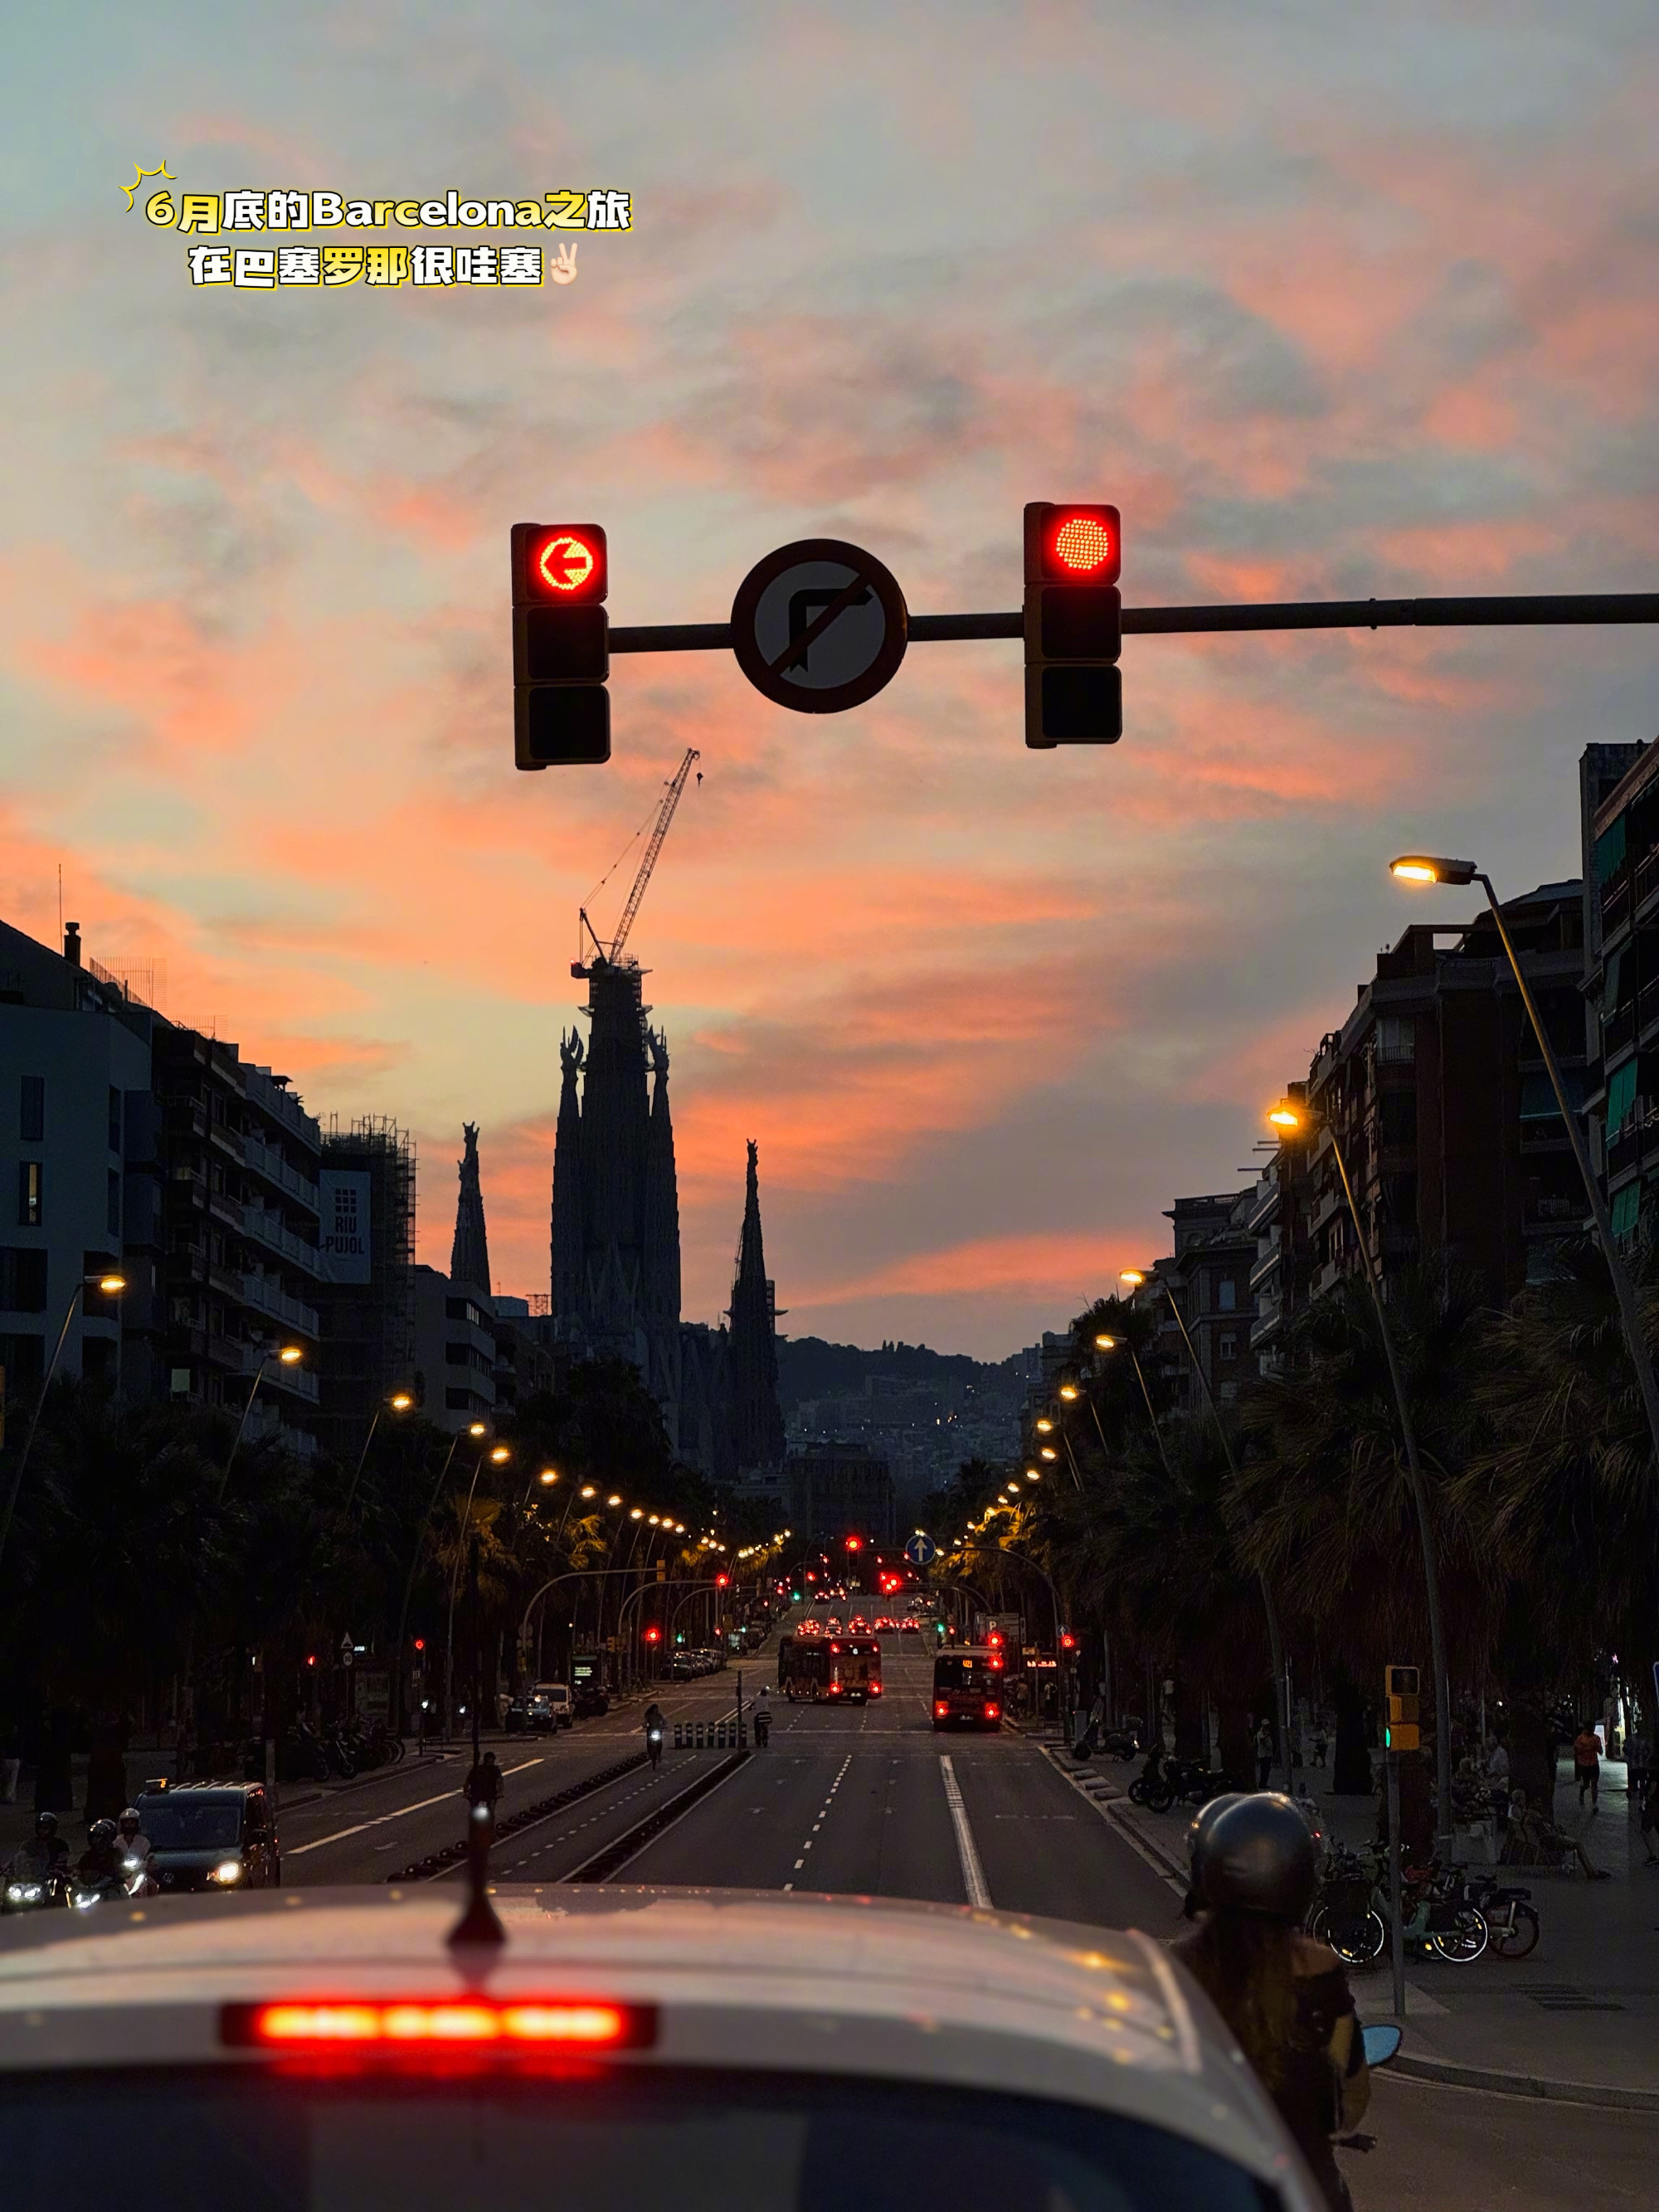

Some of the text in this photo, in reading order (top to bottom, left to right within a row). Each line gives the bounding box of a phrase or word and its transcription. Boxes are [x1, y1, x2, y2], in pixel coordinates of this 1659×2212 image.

[335, 1216, 357, 1233] RIU
[325, 1236, 365, 1254] PUJOL
[989, 1621, 997, 1631] P
